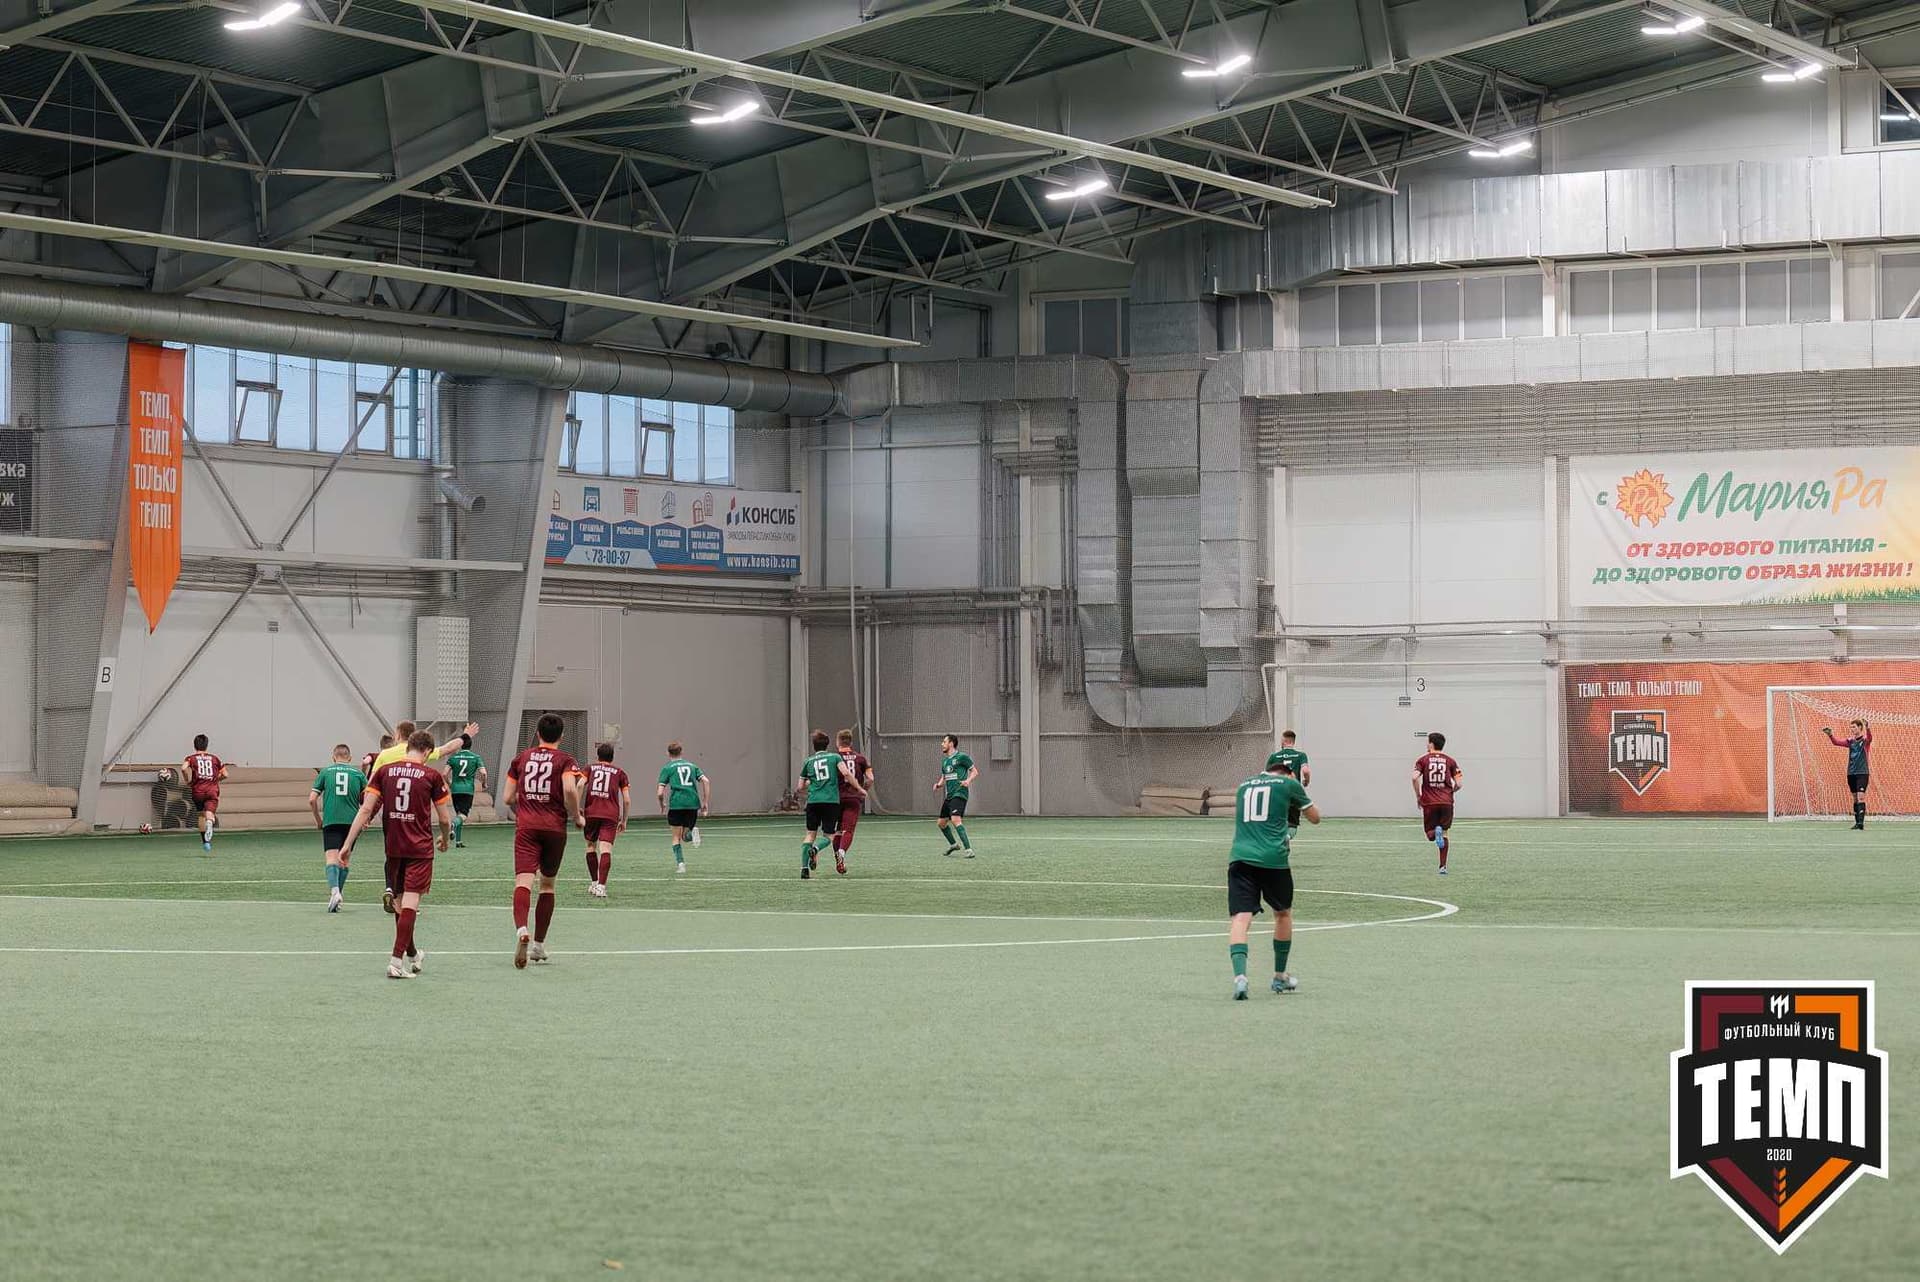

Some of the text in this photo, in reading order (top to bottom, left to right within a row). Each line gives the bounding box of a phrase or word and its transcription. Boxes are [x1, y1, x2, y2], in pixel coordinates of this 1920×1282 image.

[140, 391, 173, 422] ТЕМП,
[140, 427, 172, 459] ТЕМП,
[133, 463, 177, 493] ТОЛЬКО
[140, 501, 172, 529] ТЕМП!
[742, 507, 796, 525] КОНСИБ
[1627, 543, 1653, 557] ОТ
[1656, 541, 1774, 559] ЗДОРОВОГО
[1778, 538, 1875, 554] ПИТАНИЯ
[727, 555, 797, 568] www.konsib.com
[1592, 567, 1622, 584] ДО
[1625, 566, 1742, 584] ЗДОРОВОГО
[1745, 564, 1822, 580] ОБРАЗА
[1416, 677, 1426, 692] 3
[1578, 680, 1703, 697] ТЕМП, ТЕМП, ТОЛЬКО ТЕМП!
[1614, 734, 1665, 763] ТЕМП
[197, 760, 213, 776] 88
[459, 759, 468, 777] 2
[524, 761, 553, 793] 22
[677, 766, 693, 786] 12
[813, 758, 830, 781] 15
[1428, 762, 1447, 782] 23
[336, 772, 348, 796] 9
[592, 770, 611, 792] 21
[395, 777, 412, 811] 3
[1243, 785, 1271, 823] 10
